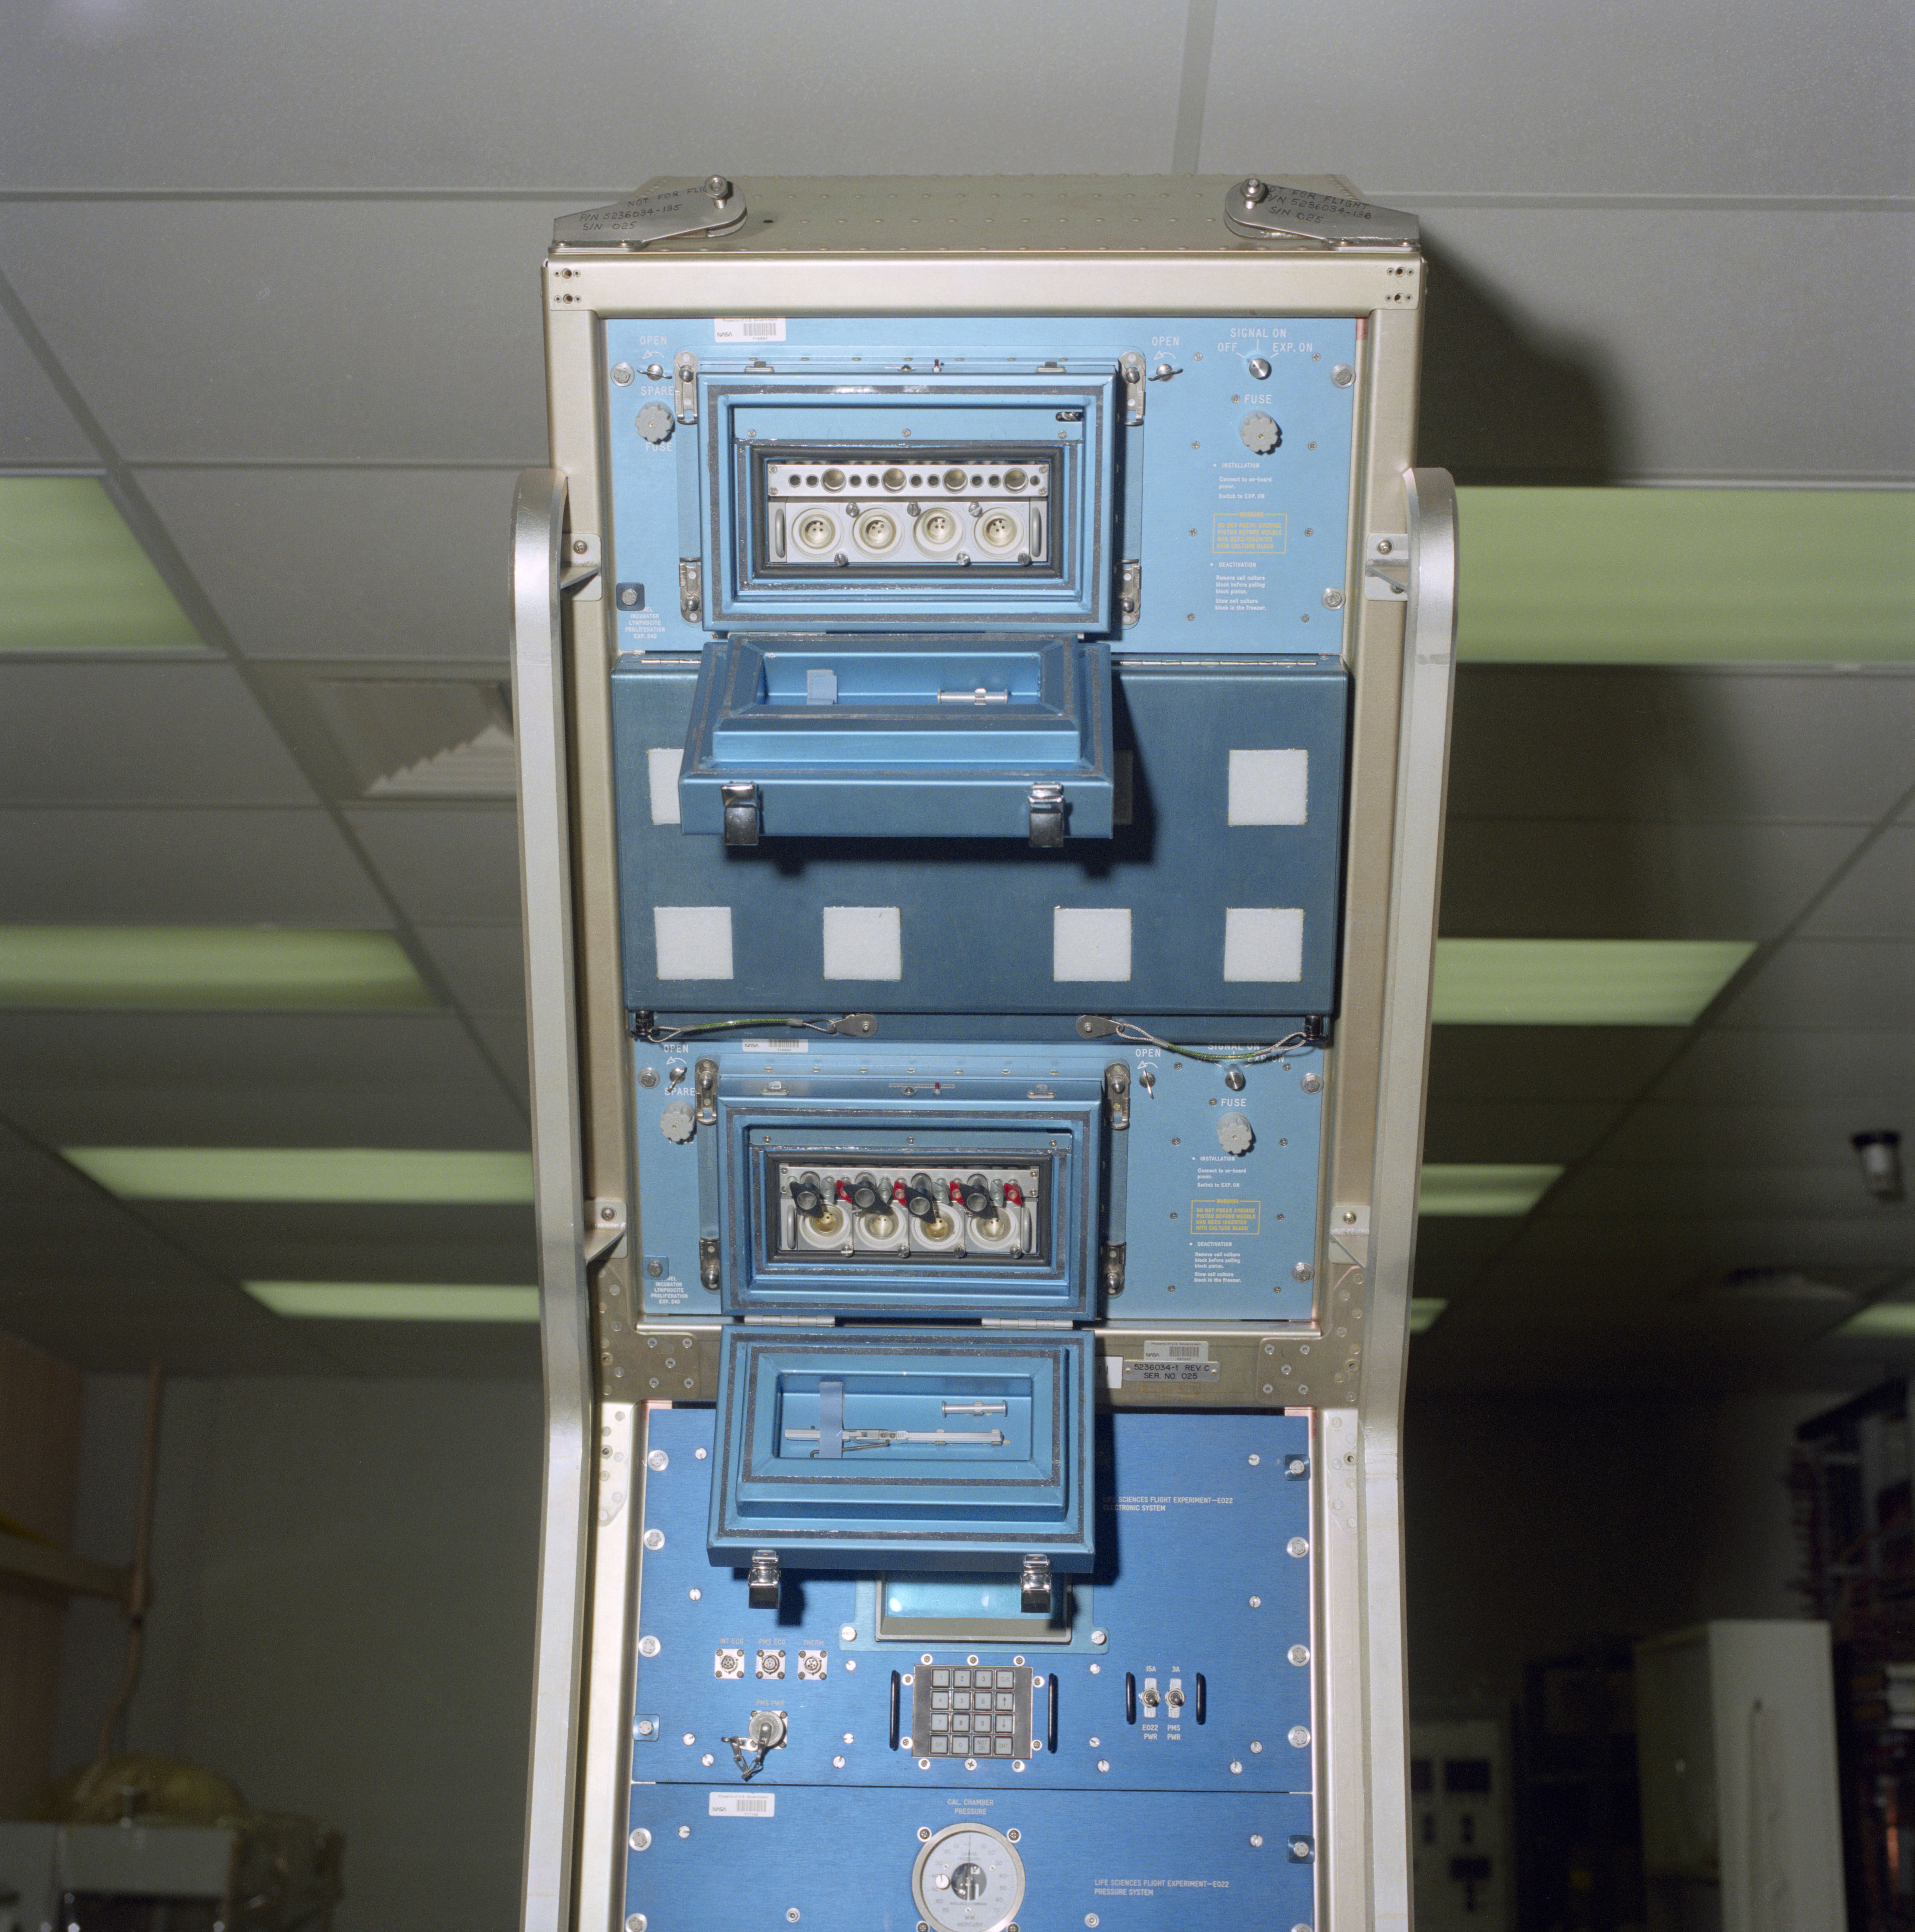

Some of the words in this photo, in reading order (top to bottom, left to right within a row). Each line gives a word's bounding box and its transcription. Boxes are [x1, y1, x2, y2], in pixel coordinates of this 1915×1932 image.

[628, 198, 649, 207] NOT
[657, 191, 679, 200] FOR
[1292, 189, 1317, 200] FOR
[1324, 196, 1371, 210] FLIGHT
[1266, 194, 1287, 204] P/N
[1290, 198, 1372, 220] 5236034-136
[580, 213, 599, 222] P/N
[603, 203, 683, 220] 5236034-135
[1269, 206, 1291, 216] S/N
[1296, 212, 1324, 223] 025
[612, 221, 637, 230] 025
[1230, 328, 1269, 338] SIGNAL
[1273, 328, 1287, 338] ON
[639, 335, 667, 345] OPEN
[1151, 336, 1180, 346] OPEN
[1217, 342, 1238, 352] OFF
[640, 386, 675, 396] SPARE
[1244, 394, 1272, 404] FUSE
[645, 442, 673, 452] FUSE
[663, 1044, 689, 1053] OPEN
[1135, 1048, 1161, 1057] OPEN
[664, 1087, 695, 1096] SPARE
[1221, 1098, 1247, 1107] FUSE
